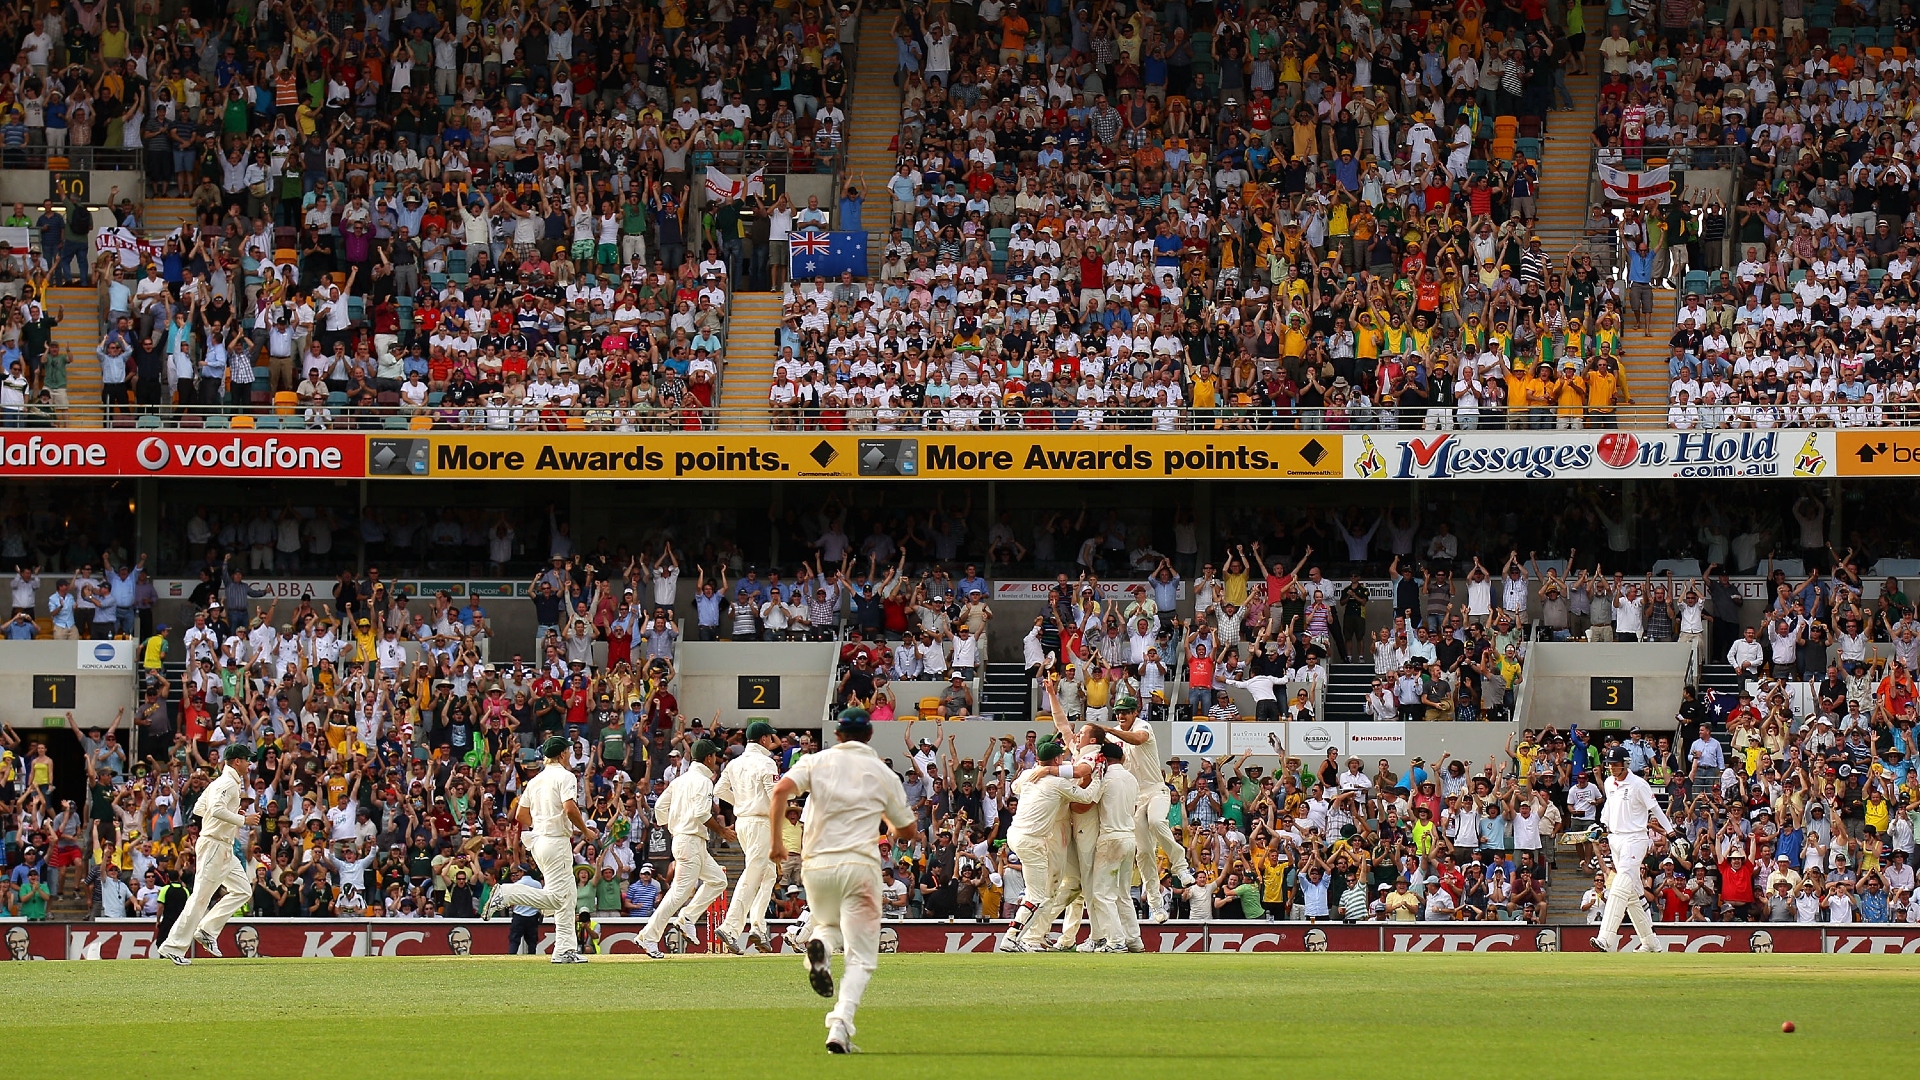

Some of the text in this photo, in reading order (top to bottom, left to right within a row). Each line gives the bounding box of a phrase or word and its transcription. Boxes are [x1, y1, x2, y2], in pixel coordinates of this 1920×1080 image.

[1669, 180, 1677, 198] 2
[0, 436, 106, 466] afone
[175, 438, 342, 468] vodafone
[437, 445, 789, 476] More Awards points.
[926, 445, 1279, 475] More Awards points.
[1392, 433, 1591, 478] Messages
[1669, 432, 1777, 464] Hold
[1673, 463, 1778, 477] .com.au
[1098, 584, 1119, 592] OC
[49, 684, 57, 703] 1
[752, 685, 765, 704] 2
[1606, 686, 1618, 705] 3
[1187, 724, 1211, 753] hp
[302, 931, 426, 957] KFC
[1159, 933, 1281, 952] KFC
[1392, 934, 1513, 952] KFC
